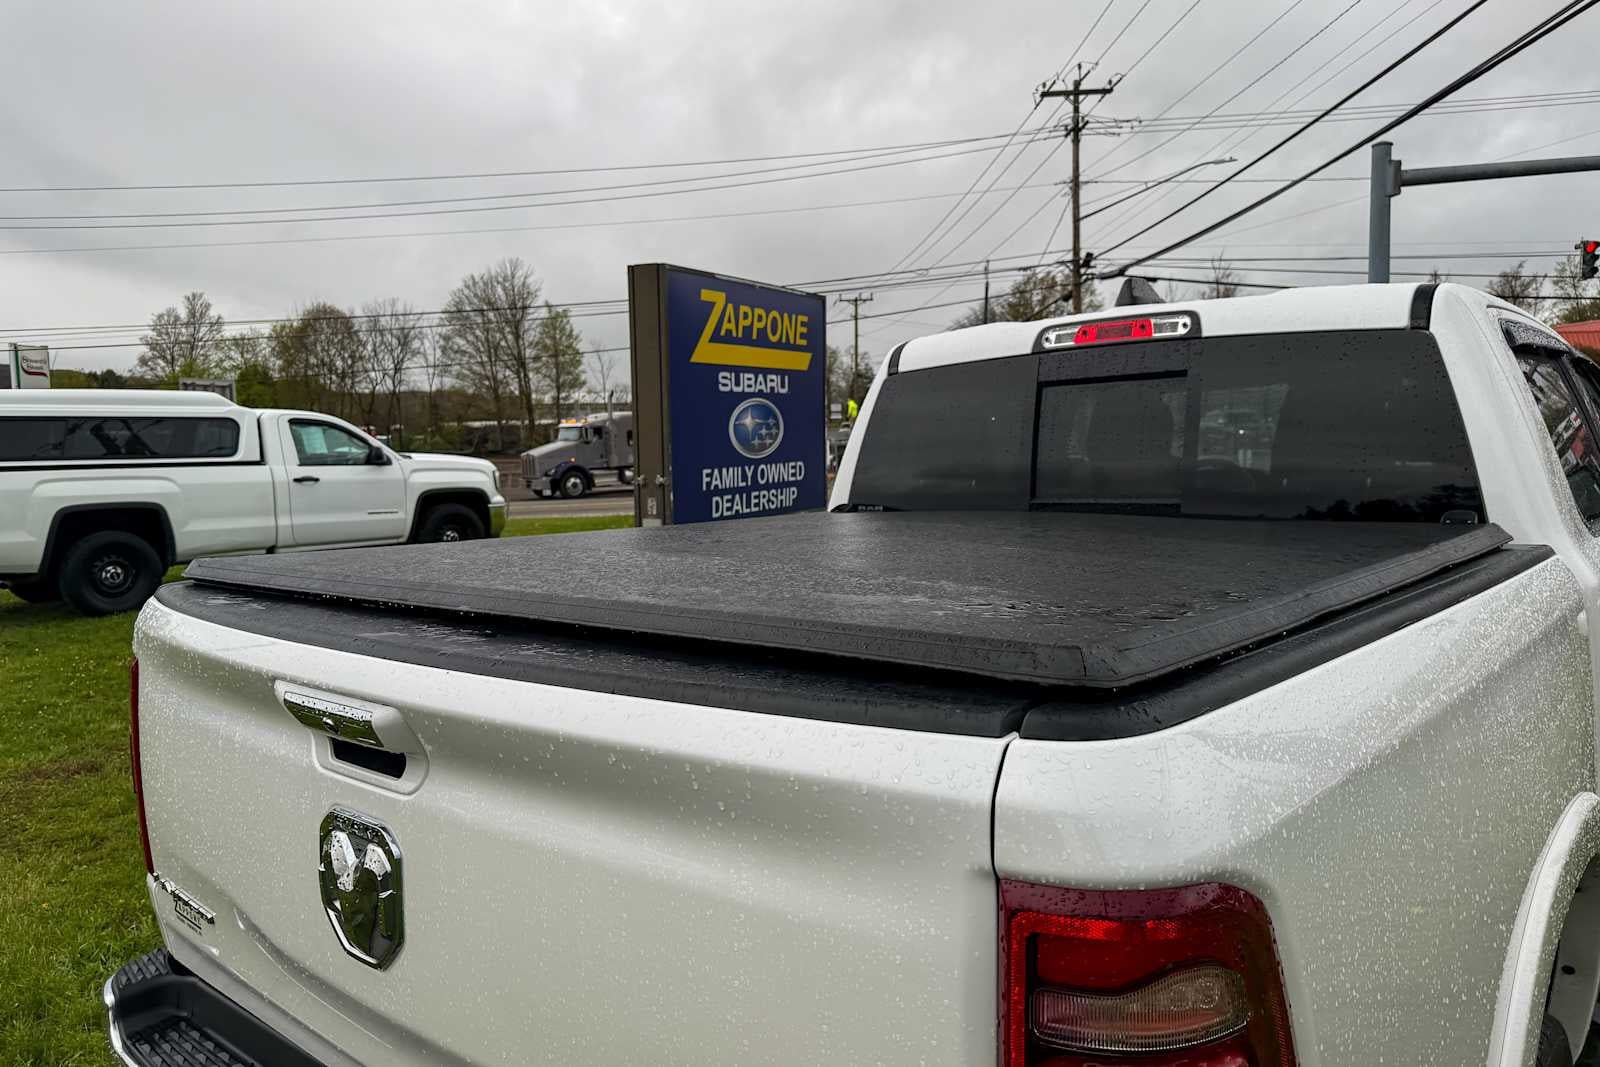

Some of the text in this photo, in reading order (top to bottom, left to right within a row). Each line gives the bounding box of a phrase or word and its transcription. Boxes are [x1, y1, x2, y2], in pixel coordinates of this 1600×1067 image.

[690, 289, 813, 371] ZAPPONE
[718, 372, 789, 393] SUBARU
[702, 461, 805, 491] FAMILY OWNED
[712, 487, 798, 518] DEALERSHIP
